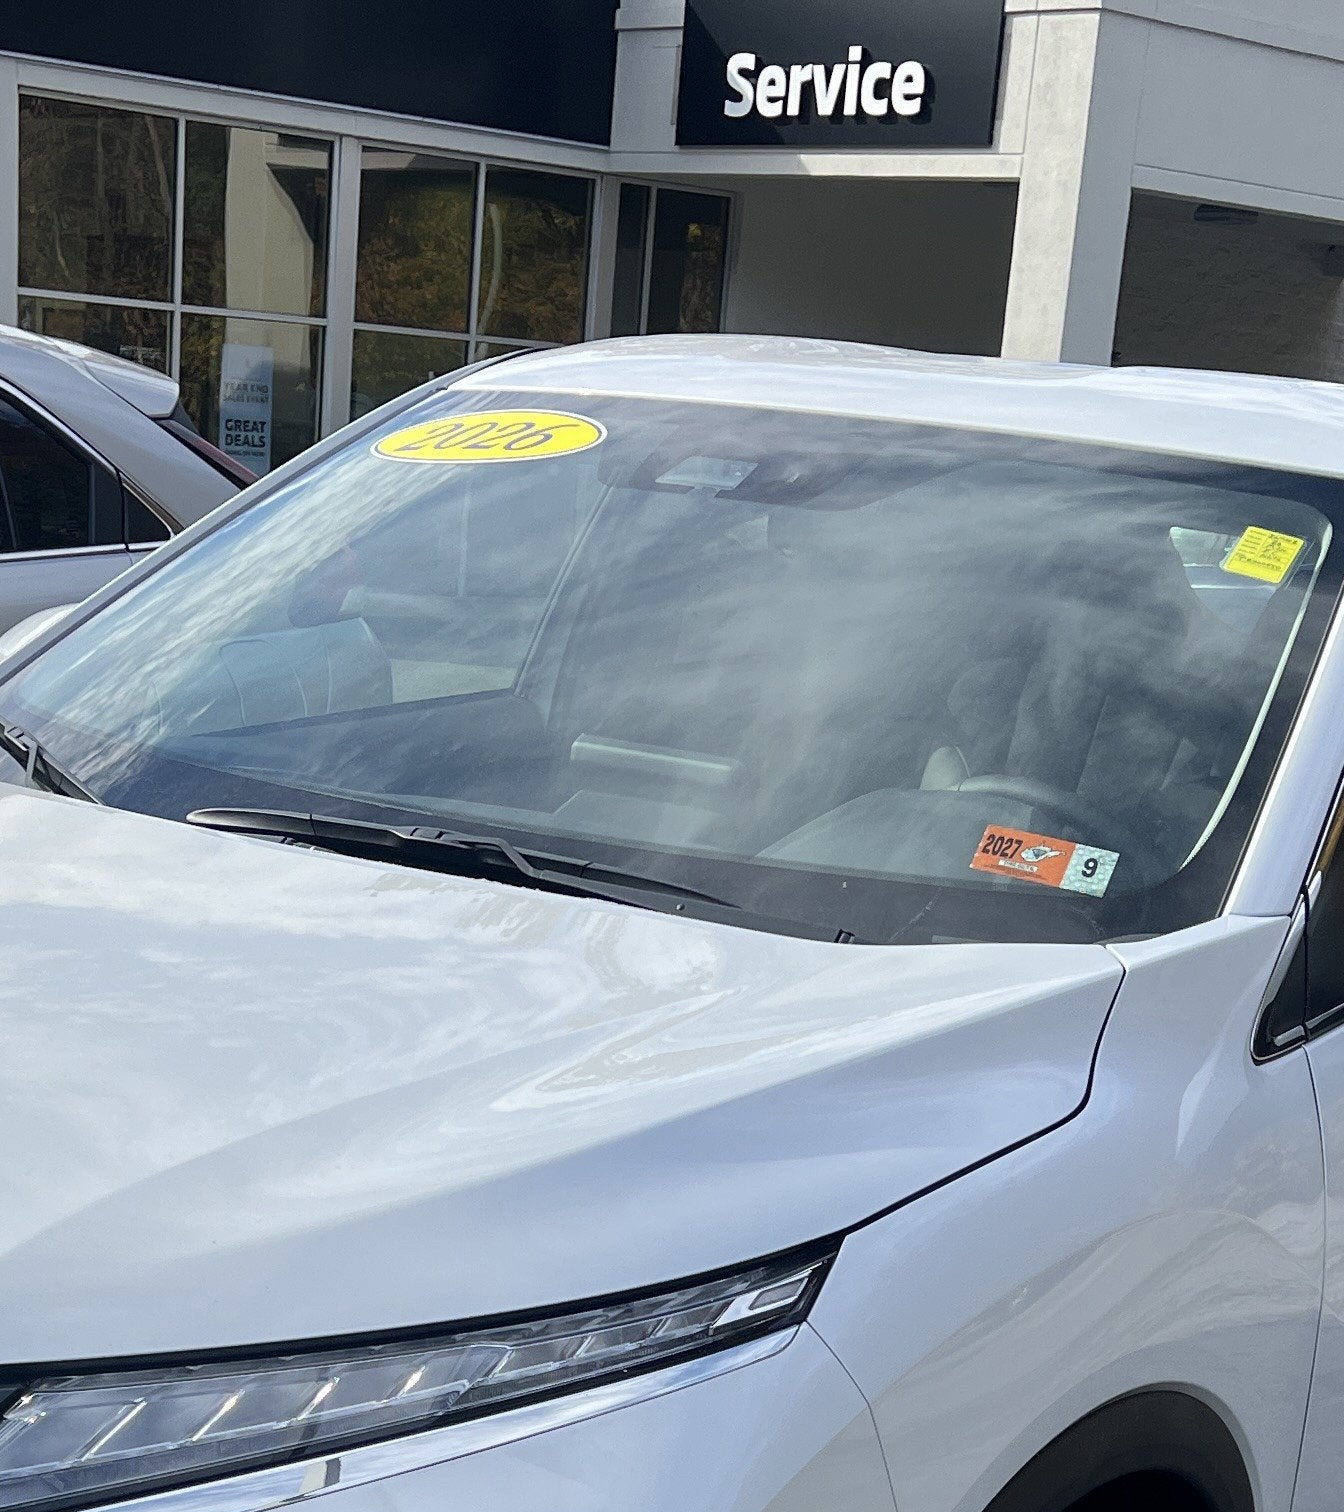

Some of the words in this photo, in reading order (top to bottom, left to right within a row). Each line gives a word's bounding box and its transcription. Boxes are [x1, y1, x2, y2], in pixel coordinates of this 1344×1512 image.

[723, 45, 926, 118] Service
[225, 419, 267, 433] GREAT
[393, 422, 580, 451] 2026
[225, 434, 266, 448] DEALS
[981, 833, 1024, 860] 2027
[1081, 856, 1099, 879] 9
